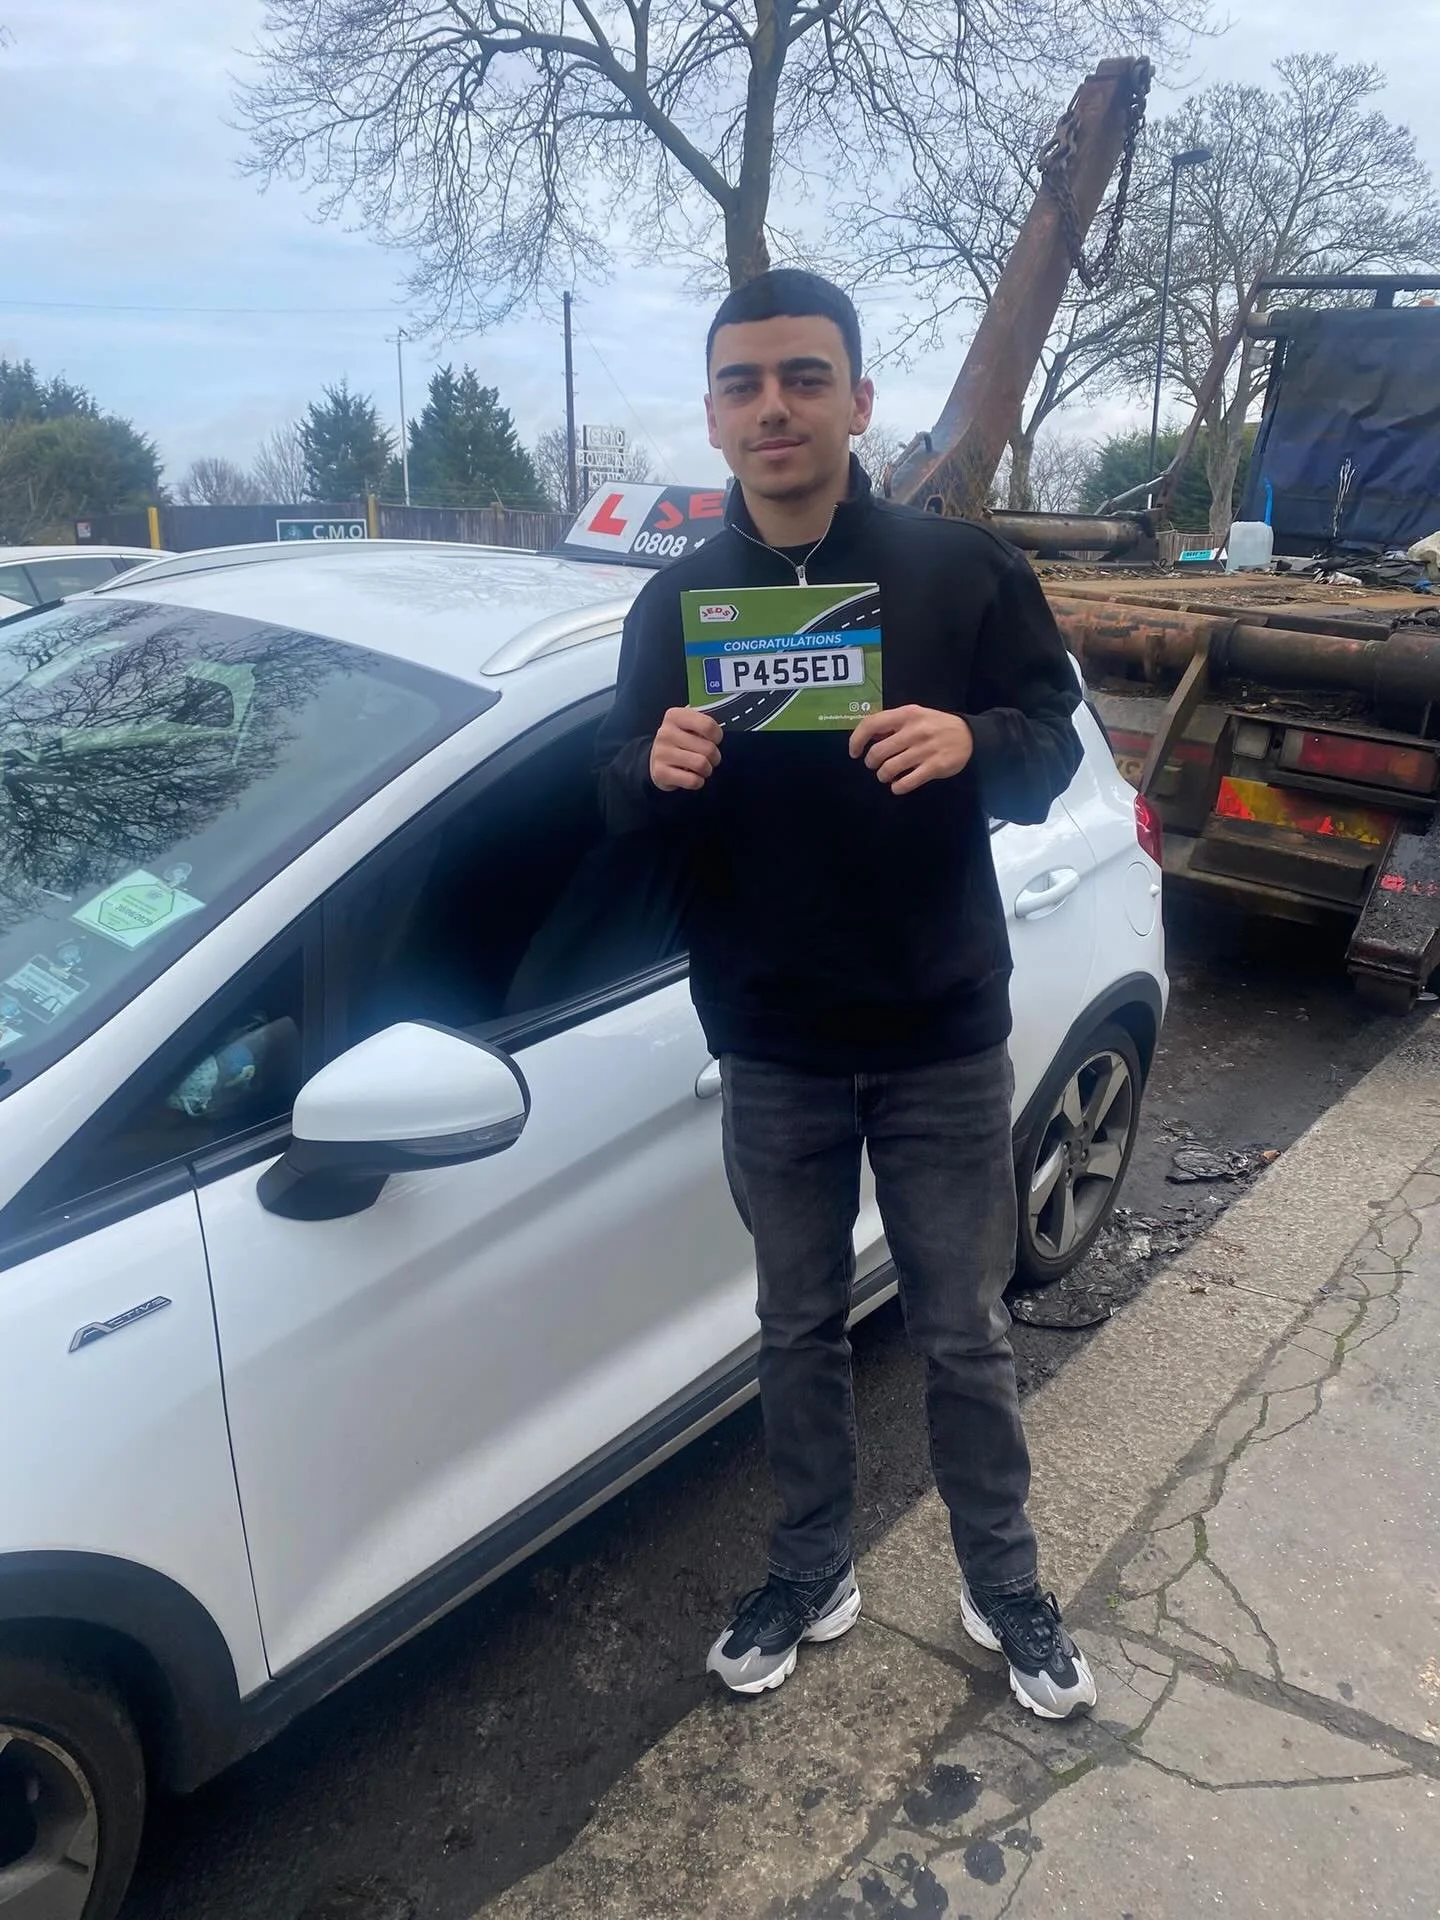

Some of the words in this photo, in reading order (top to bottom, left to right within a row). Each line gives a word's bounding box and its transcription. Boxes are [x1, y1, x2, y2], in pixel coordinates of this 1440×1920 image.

[587, 493, 628, 536] L
[653, 490, 725, 530] JE
[634, 531, 688, 558] 0808
[701, 607, 731, 618] JEDS
[724, 633, 843, 652] CONGRATULATIONS
[733, 654, 850, 688] P455ED
